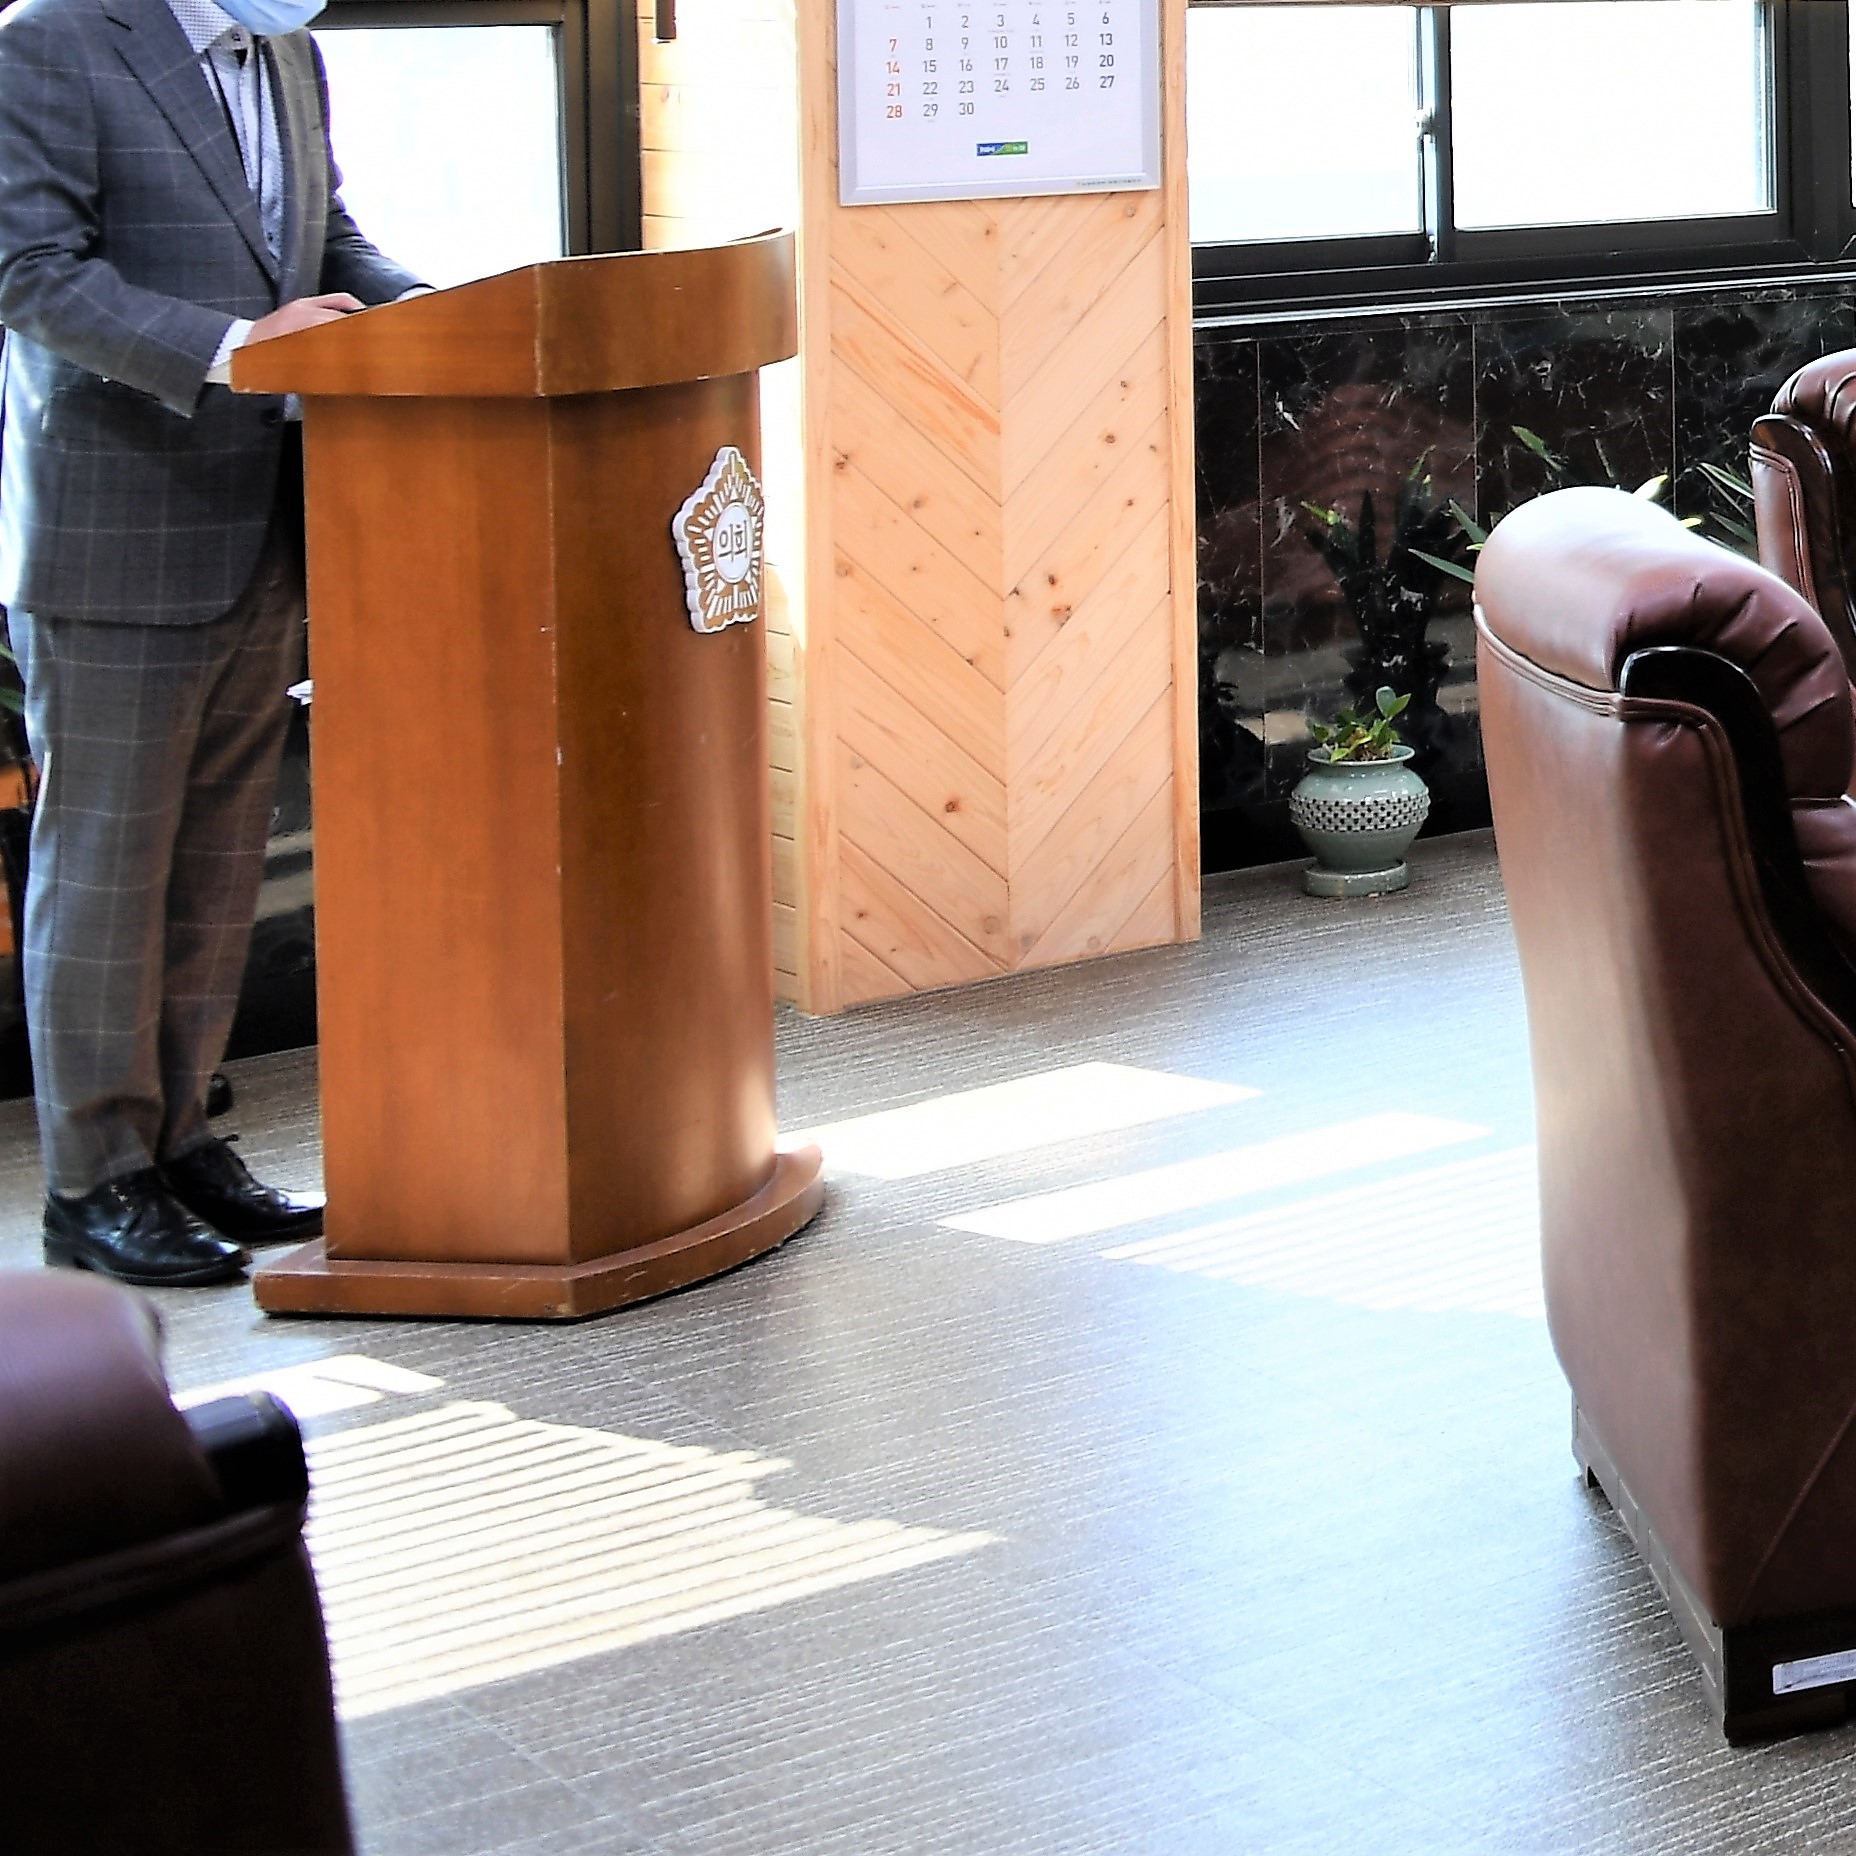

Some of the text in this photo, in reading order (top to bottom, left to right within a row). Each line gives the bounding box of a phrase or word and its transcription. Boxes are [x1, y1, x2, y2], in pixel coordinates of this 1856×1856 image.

[993, 36, 1008, 49] 10
[1030, 34, 1042, 48] 11
[1064, 33, 1078, 47] 12
[1099, 32, 1113, 46] 13
[886, 54, 1115, 74] 14 15 16 17 18 19 20
[887, 75, 1115, 97] 21 22 23 24 25 26 27
[886, 101, 975, 119] 28 29 30
[719, 520, 748, 563] 의회
